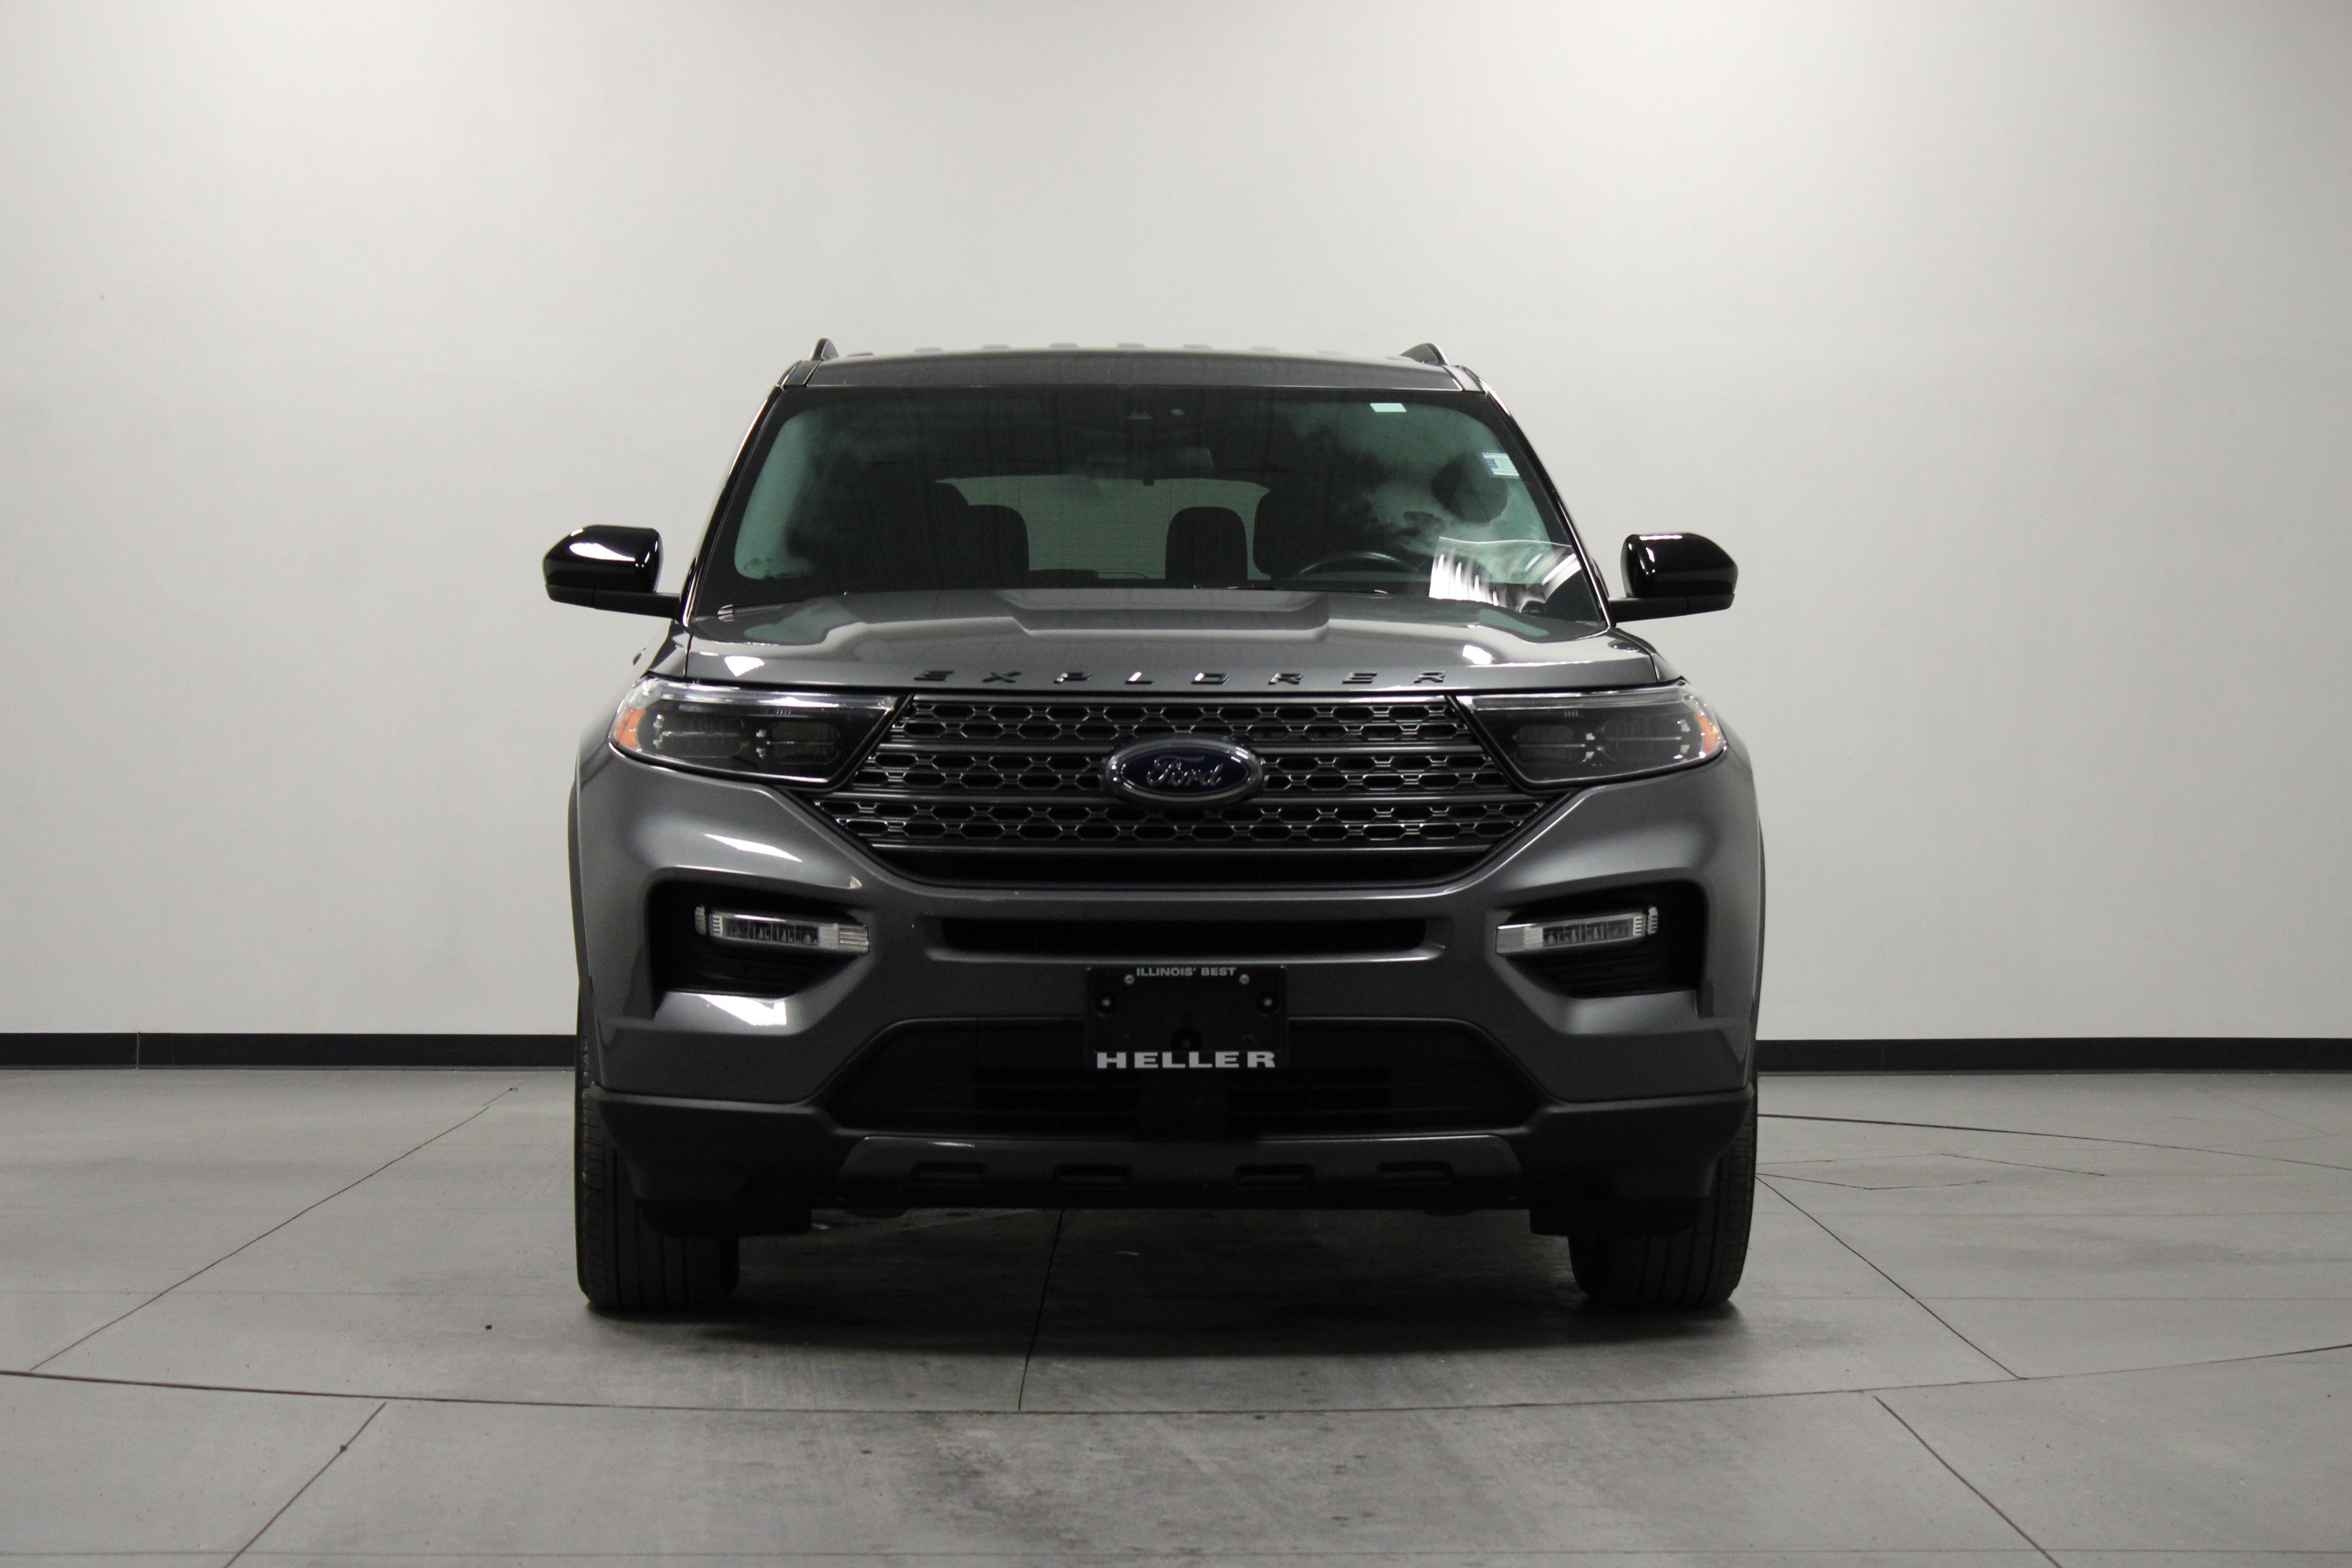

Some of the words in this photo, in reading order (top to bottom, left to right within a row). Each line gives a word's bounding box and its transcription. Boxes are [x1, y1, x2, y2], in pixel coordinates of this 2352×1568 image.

[913, 670, 1446, 684] EXPLORER
[1145, 755, 1223, 787] Ford
[1136, 967, 1196, 976] ILLINOIS'
[1201, 967, 1236, 976] BEST
[1096, 1051, 1276, 1069] HELLER
